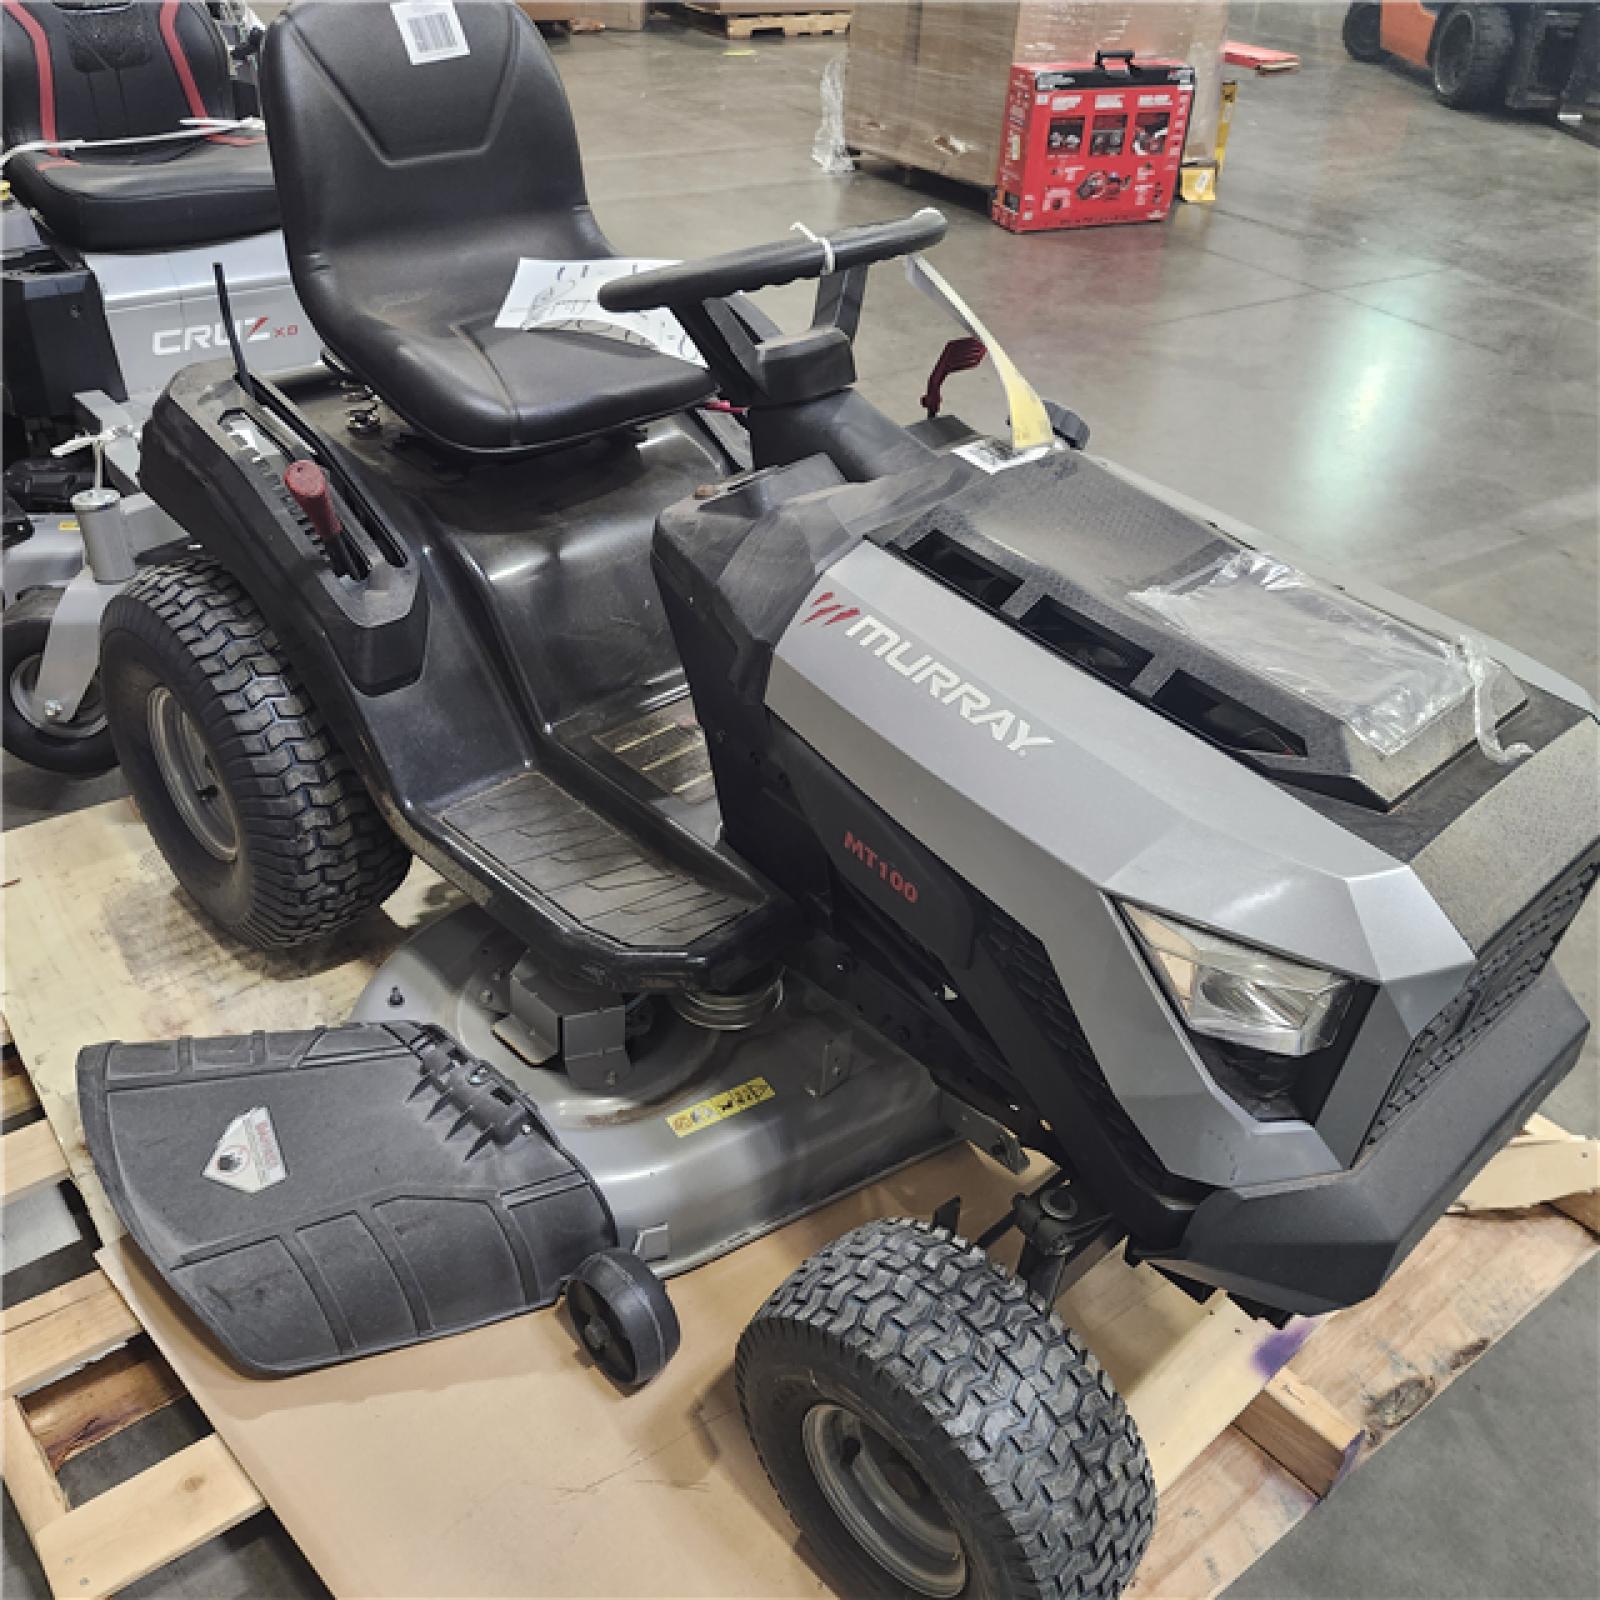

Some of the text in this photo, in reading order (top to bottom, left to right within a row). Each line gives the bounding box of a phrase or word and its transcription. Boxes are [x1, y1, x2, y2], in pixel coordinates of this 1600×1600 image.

[152, 316, 271, 355] CRUZ
[844, 614, 1054, 752] MURRAY
[844, 831, 919, 903] MT100
